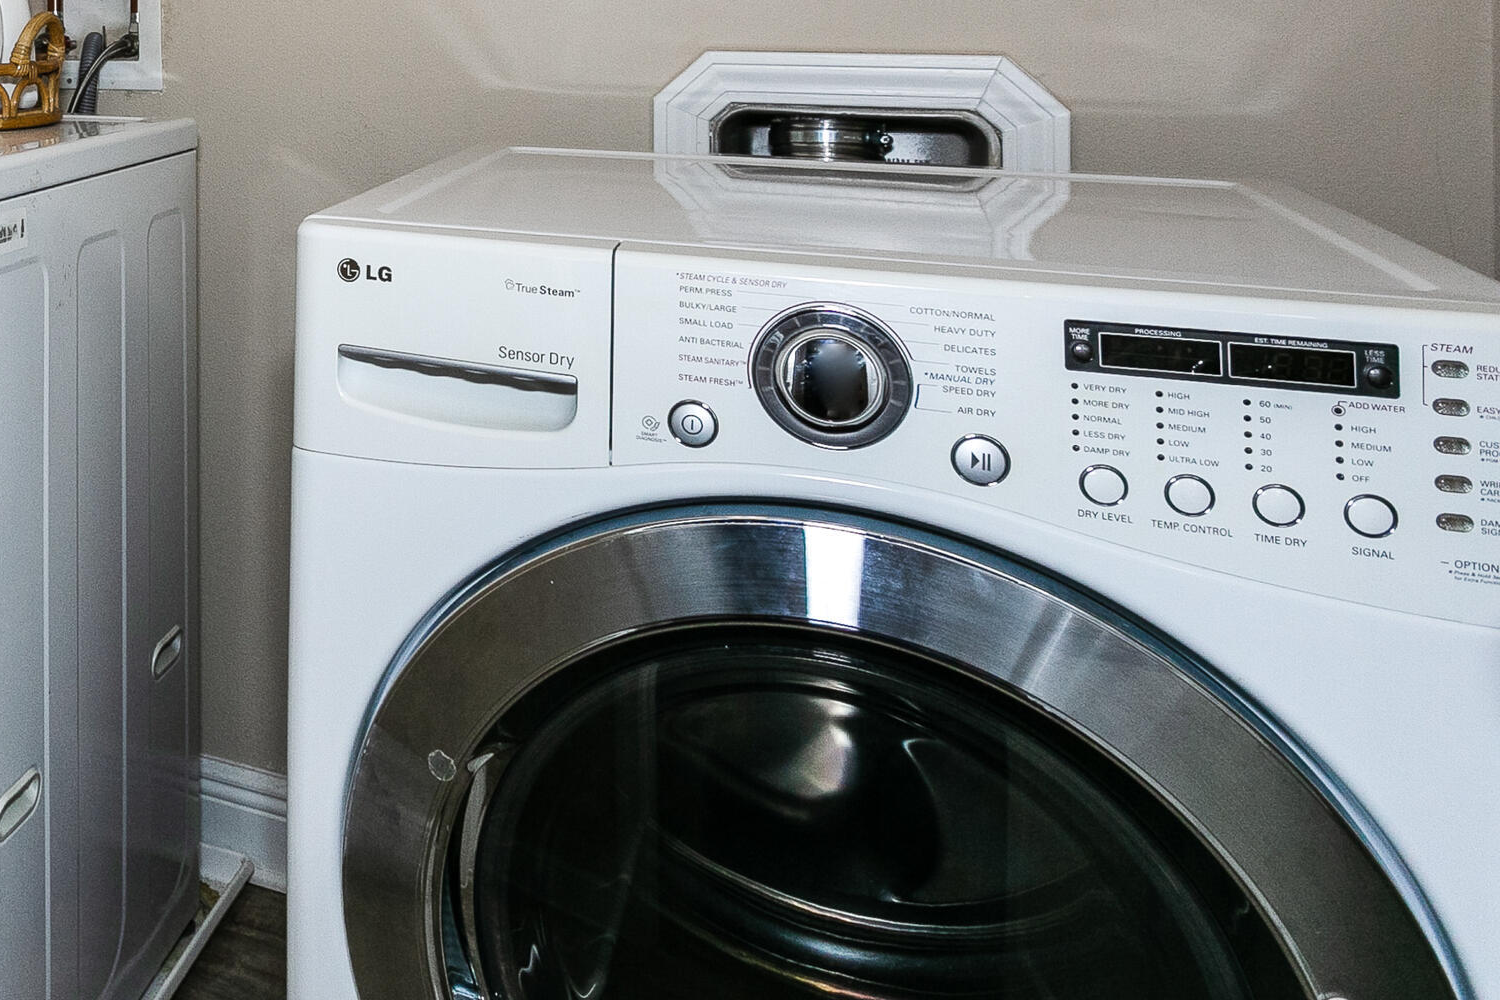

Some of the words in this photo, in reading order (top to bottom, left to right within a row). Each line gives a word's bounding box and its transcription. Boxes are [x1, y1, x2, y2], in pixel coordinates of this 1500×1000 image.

[366, 265, 392, 282] LG
[707, 275, 729, 284] CYCLE
[739, 278, 770, 287] SENSOR
[516, 282, 537, 294] True
[705, 288, 732, 297] PRESS
[679, 301, 737, 313] BULKY/LARGE
[910, 306, 996, 321] COTTON/NORMAL
[679, 318, 707, 327] SMALL
[709, 320, 733, 329] LOAD
[934, 325, 966, 335] HEAVY
[969, 328, 996, 338] DUTY
[1134, 328, 1182, 338] PROCESSING
[678, 336, 697, 344] ANTI
[700, 337, 744, 349] BACTERIAL
[1288, 340, 1328, 349] REMAINING
[944, 344, 996, 356] DELICATES
[1430, 343, 1474, 354] STEAM
[498, 346, 545, 364] Sensor
[549, 351, 575, 370] Dry
[678, 354, 703, 363] STEAM
[955, 365, 996, 376] TOWELS
[678, 374, 707, 383] STEAM
[975, 377, 995, 386] DRY
[942, 385, 973, 396] SPEED
[976, 389, 996, 398] DRY
[1083, 383, 1107, 392] VERY
[1109, 386, 1127, 394] DRY
[1167, 392, 1190, 400] HIGH
[1083, 399, 1109, 408] MORE
[1112, 402, 1130, 410] DRY
[1259, 400, 1271, 408] 60
[1348, 401, 1370, 410] ADD
[1372, 404, 1406, 414] WATER
[957, 406, 973, 414] AIR
[976, 408, 996, 417] DRY
[1168, 408, 1185, 416] MID
[1187, 410, 1210, 418] HIGH
[1083, 415, 1122, 425] NORMAL
[1260, 416, 1271, 424] 50
[1168, 424, 1207, 433] MEDIUM
[1351, 426, 1377, 434] HIGH
[1083, 430, 1106, 439] LESS
[1108, 432, 1126, 441] DRY
[1168, 439, 1189, 448] LOW
[1351, 442, 1392, 452] MEDIUM
[1083, 446, 1110, 455] DAMP
[1112, 449, 1130, 457] DRY
[1480, 449, 1500, 457] PRO
[1169, 456, 1197, 465] ULTRA
[1199, 459, 1219, 467] LOW
[1351, 458, 1374, 467] LOW
[1352, 475, 1370, 483] OFF
[1077, 509, 1099, 520] DRY
[1101, 512, 1133, 524] LEVEL
[1152, 519, 1180, 531] TEMP.
[1183, 523, 1233, 538] CONTROL
[1254, 533, 1281, 545] TIME
[1285, 536, 1308, 548] DRY
[1351, 546, 1395, 561] SIGNAL
[1454, 560, 1499, 573] OPTION
